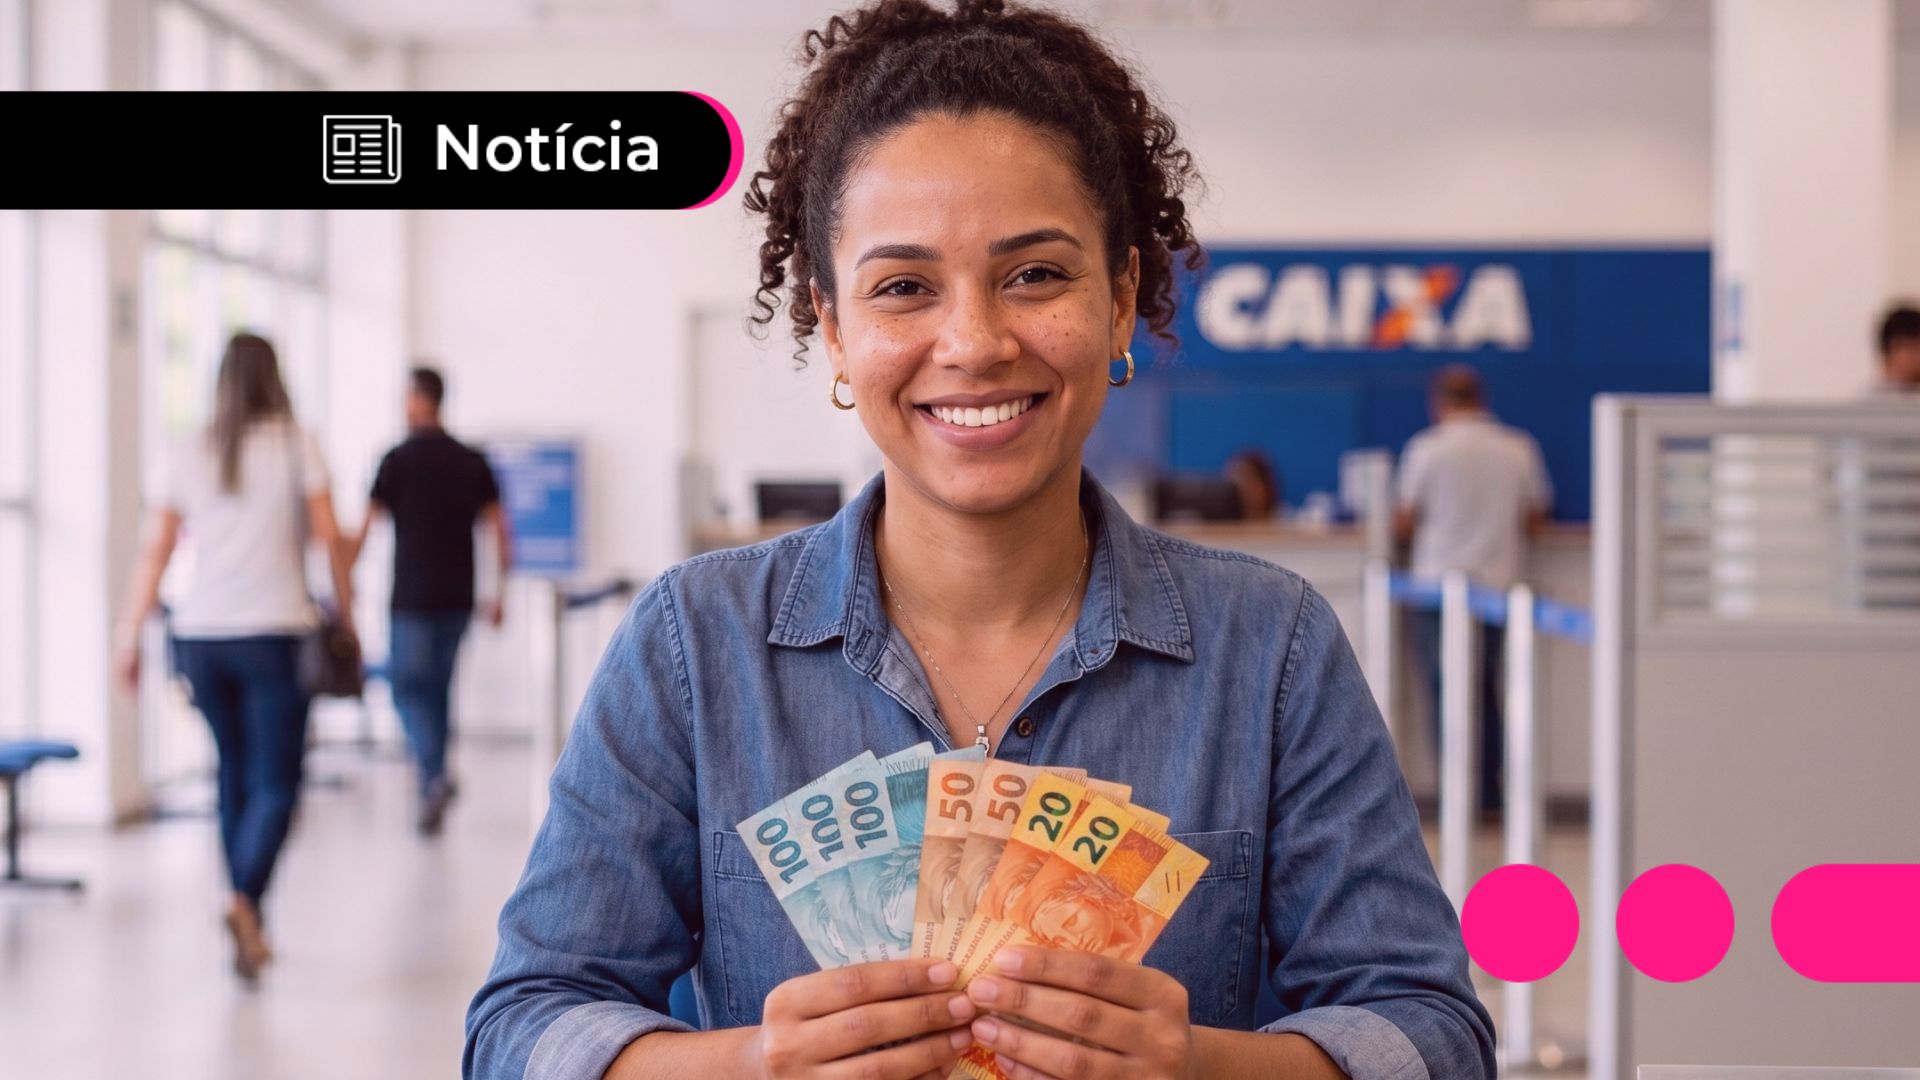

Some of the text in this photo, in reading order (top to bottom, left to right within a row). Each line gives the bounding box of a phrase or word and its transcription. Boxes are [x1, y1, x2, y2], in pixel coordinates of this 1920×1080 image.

[1197, 263, 1533, 350] CAIXA
[844, 781, 887, 850] 100
[939, 772, 976, 822] 50
[987, 773, 1027, 825] 50
[1028, 791, 1072, 842] 20
[756, 817, 809, 884] 100
[801, 794, 844, 862] 100
[1072, 816, 1121, 865] 20
